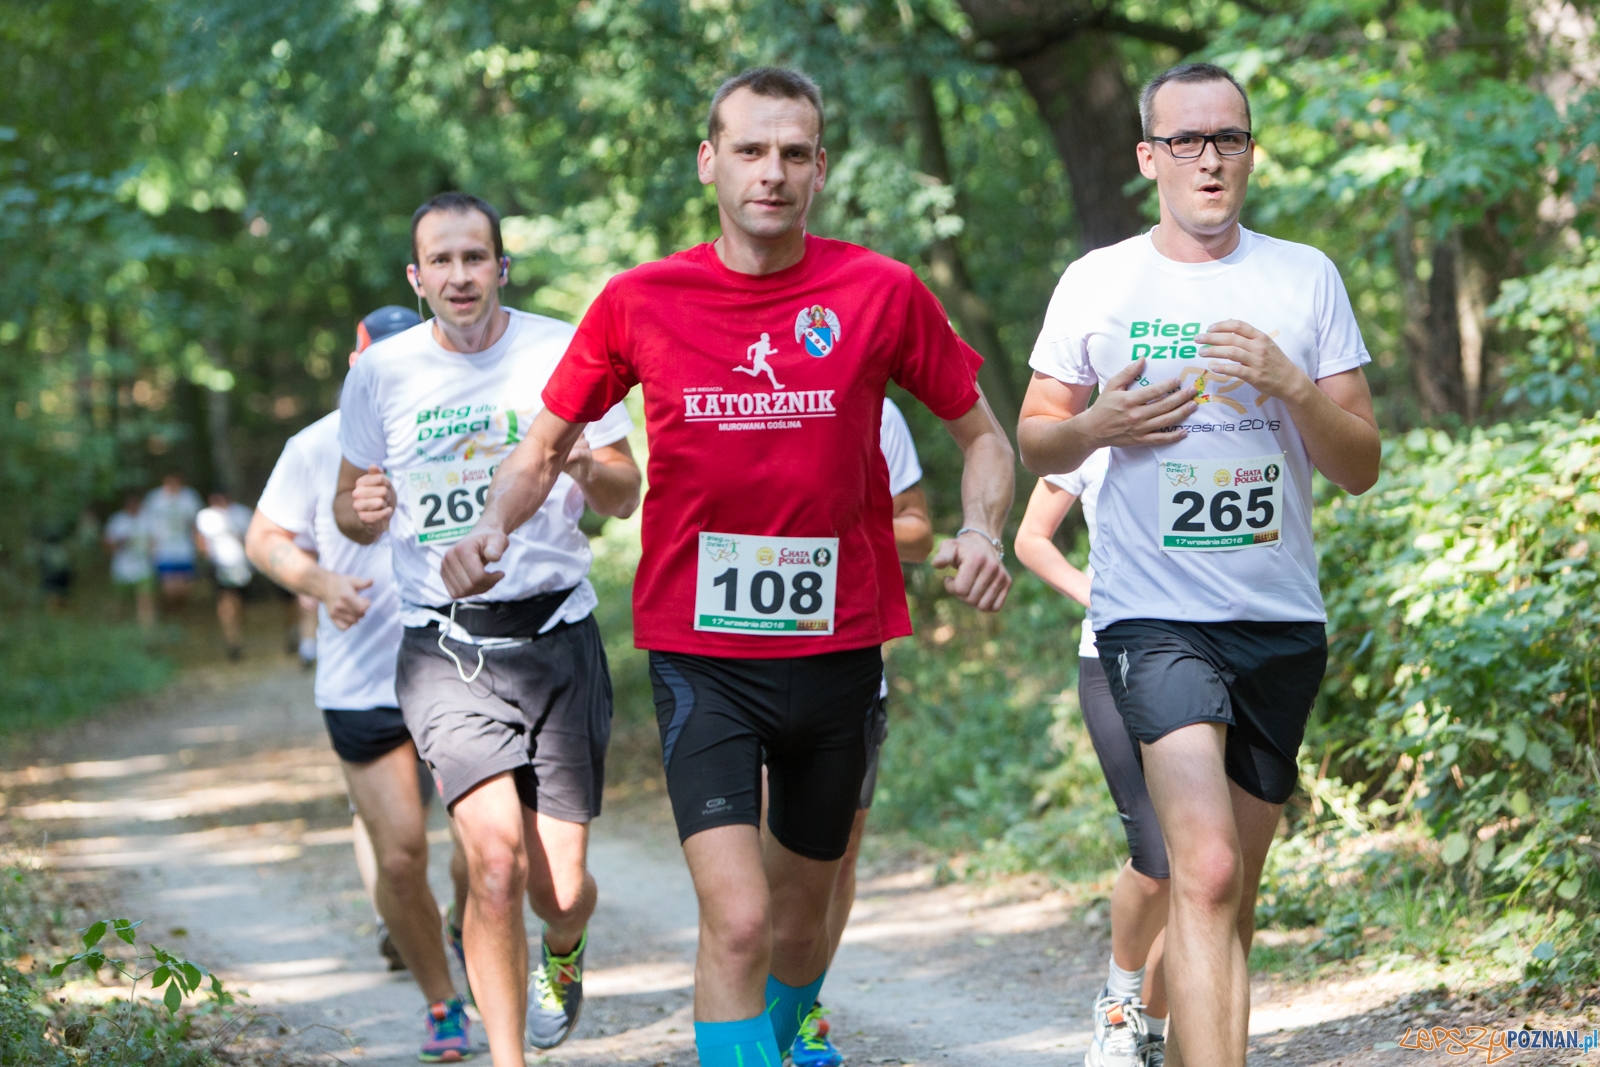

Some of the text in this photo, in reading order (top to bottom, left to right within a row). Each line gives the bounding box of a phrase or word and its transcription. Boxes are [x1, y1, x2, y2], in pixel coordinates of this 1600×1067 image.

[1129, 318, 1202, 342] Bieg
[1131, 340, 1212, 361] Dzie
[416, 404, 498, 424] Bieg dla
[417, 415, 491, 441] Dzieci
[718, 419, 802, 432] MUROWANA GOŚLINA
[1235, 467, 1262, 478] CHATA
[1234, 475, 1264, 487] POLSKA
[1171, 486, 1275, 533] 265
[780, 547, 810, 558] CHATA
[777, 556, 812, 567] POLSKA
[713, 567, 823, 615] 108
[711, 617, 723, 625] 17
